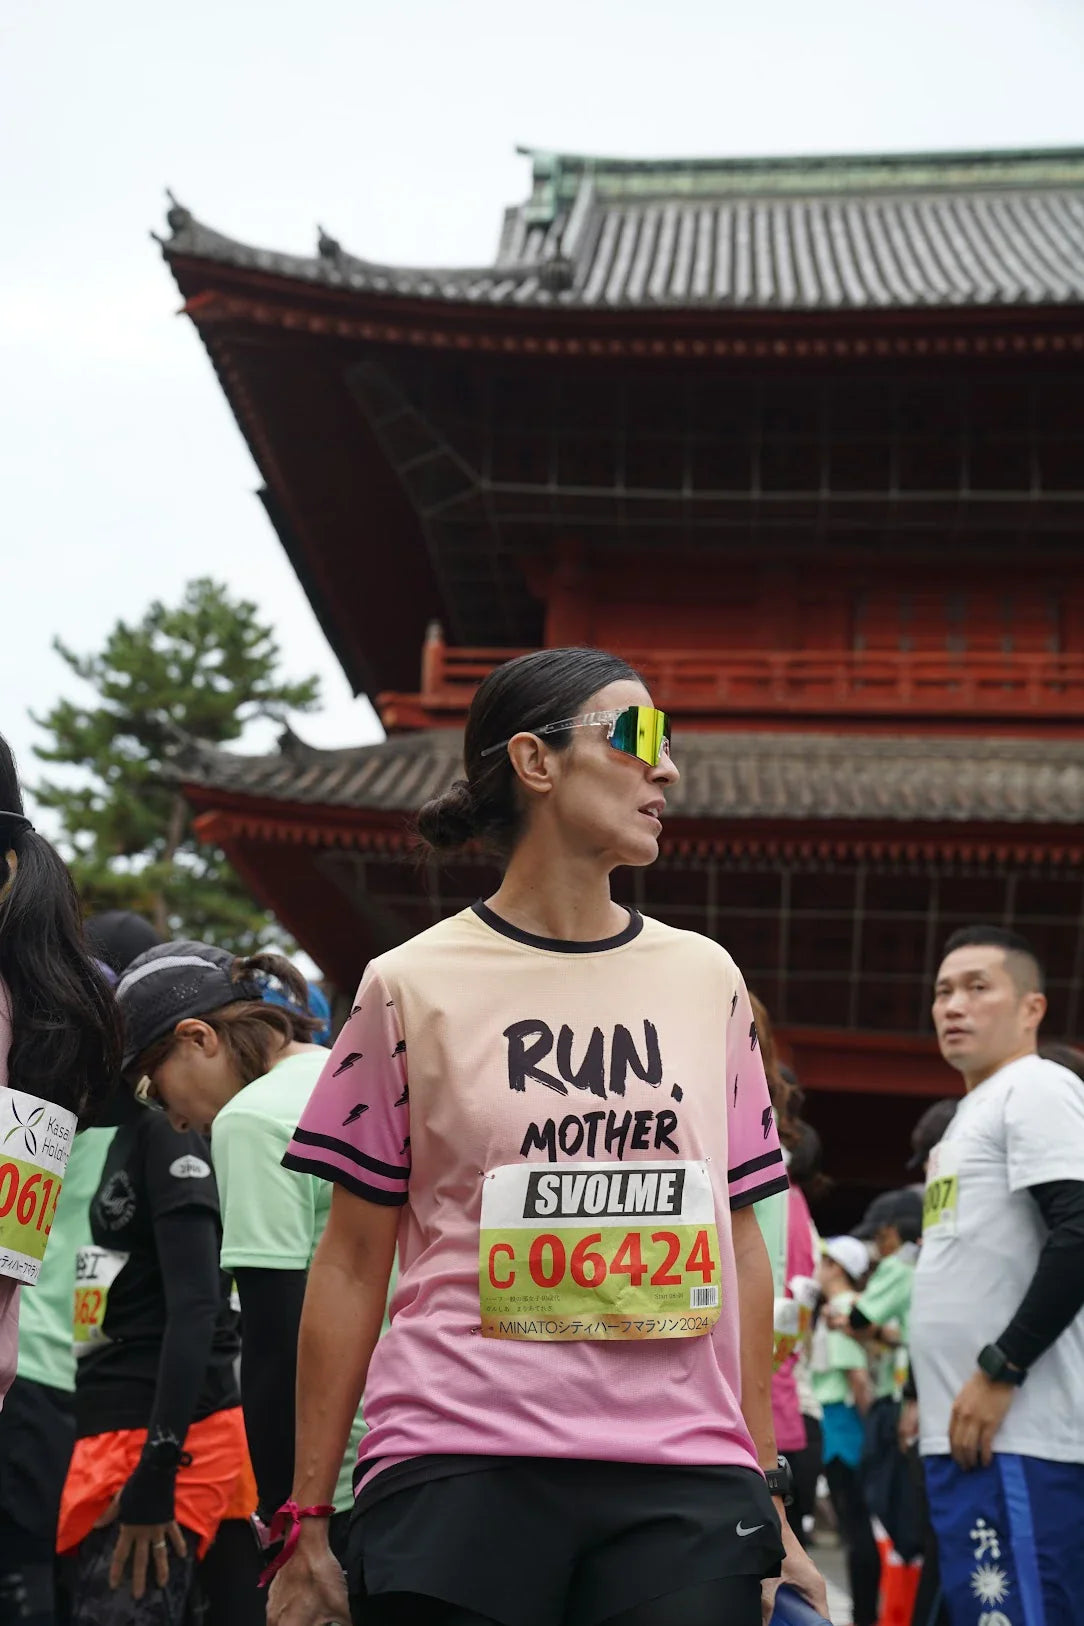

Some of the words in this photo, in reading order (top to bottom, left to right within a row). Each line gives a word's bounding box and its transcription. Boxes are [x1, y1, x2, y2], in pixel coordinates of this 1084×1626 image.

[503, 1019, 683, 1102] RUN.
[520, 1110, 679, 1162] MOTHER
[535, 1173, 677, 1215] SVOLME
[488, 1243, 516, 1290] C
[528, 1230, 715, 1288] 06424
